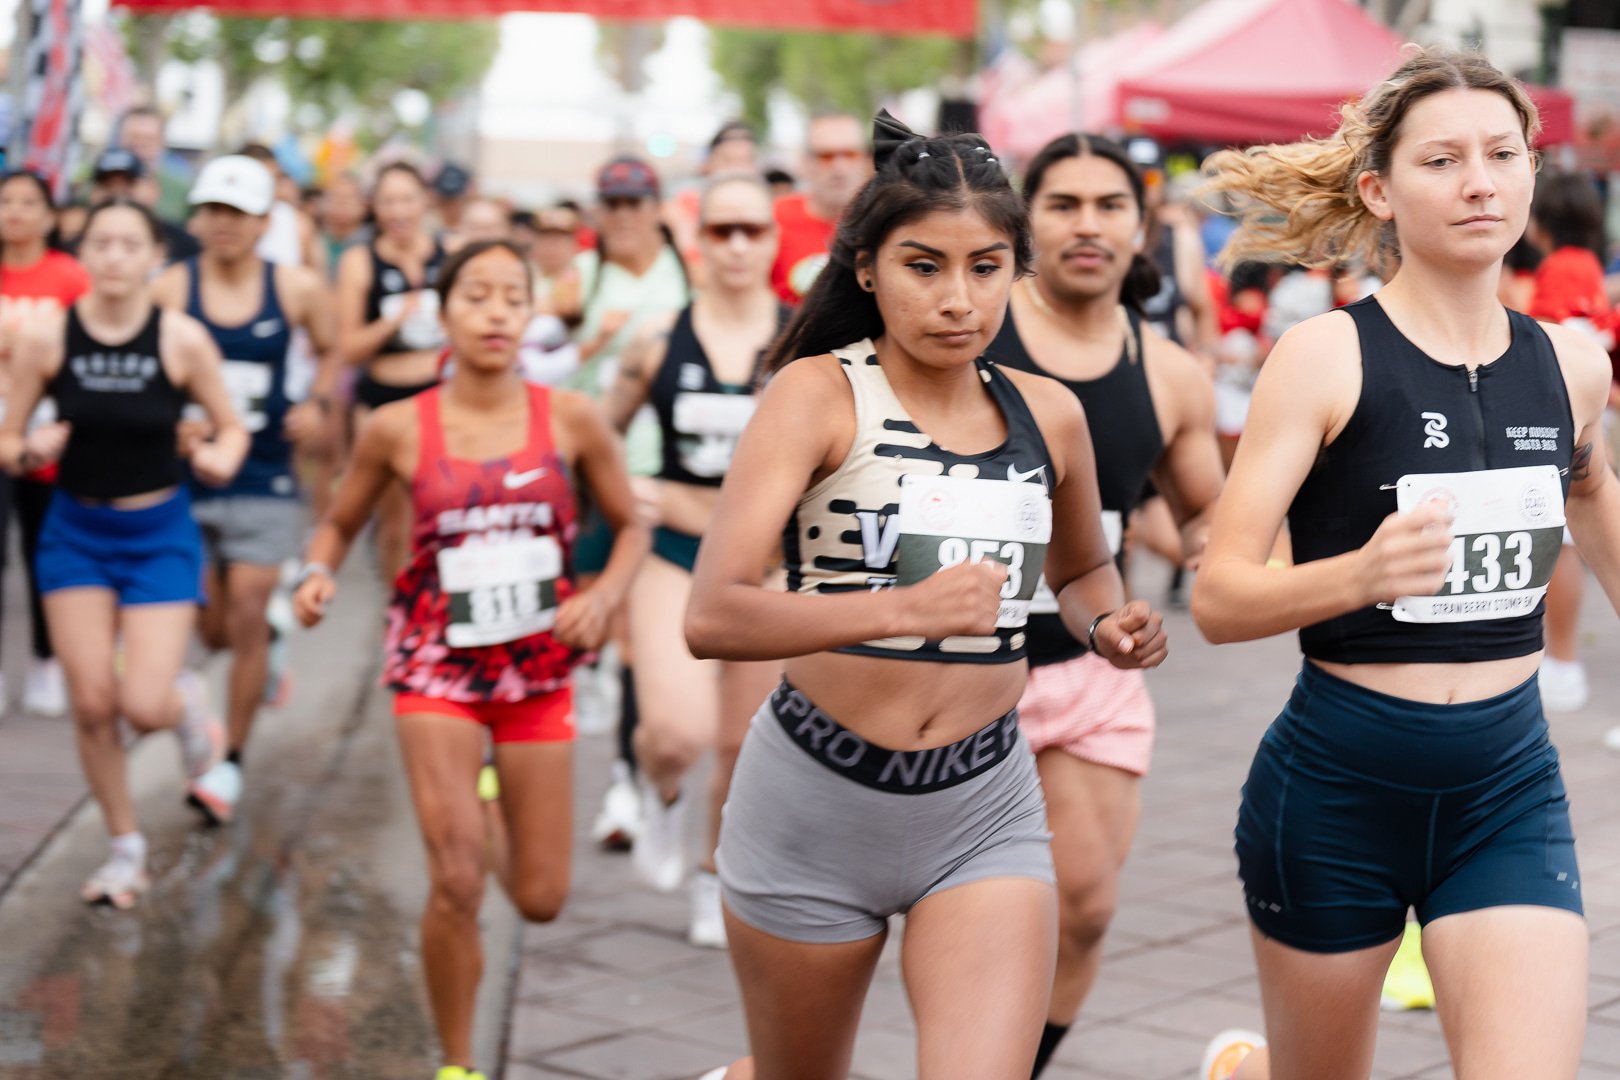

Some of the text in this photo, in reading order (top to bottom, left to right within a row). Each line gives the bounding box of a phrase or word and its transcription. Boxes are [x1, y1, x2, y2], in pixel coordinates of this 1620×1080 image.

[1445, 531, 1533, 594] 433
[778, 689, 868, 768] PRO
[876, 720, 998, 787] NIKE
